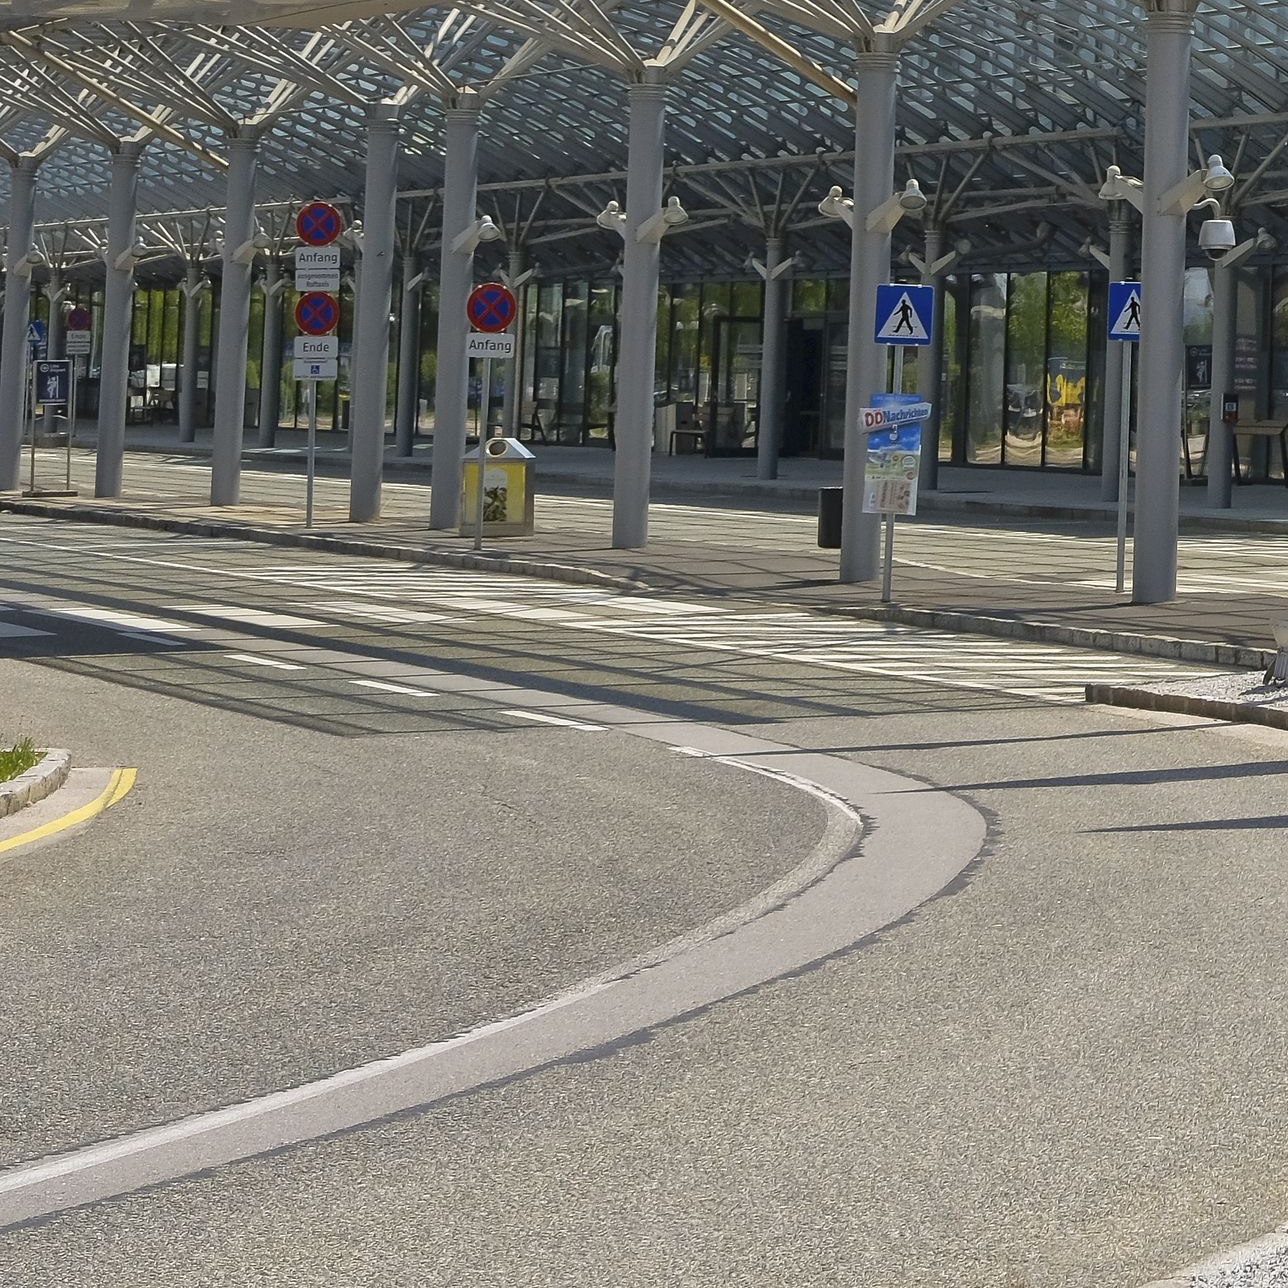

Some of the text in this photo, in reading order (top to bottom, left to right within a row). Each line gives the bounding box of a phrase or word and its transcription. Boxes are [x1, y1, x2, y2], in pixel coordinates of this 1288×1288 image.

[298, 252, 338, 264] Anfang
[303, 342, 330, 352] Ende
[469, 339, 512, 354] Anfang
